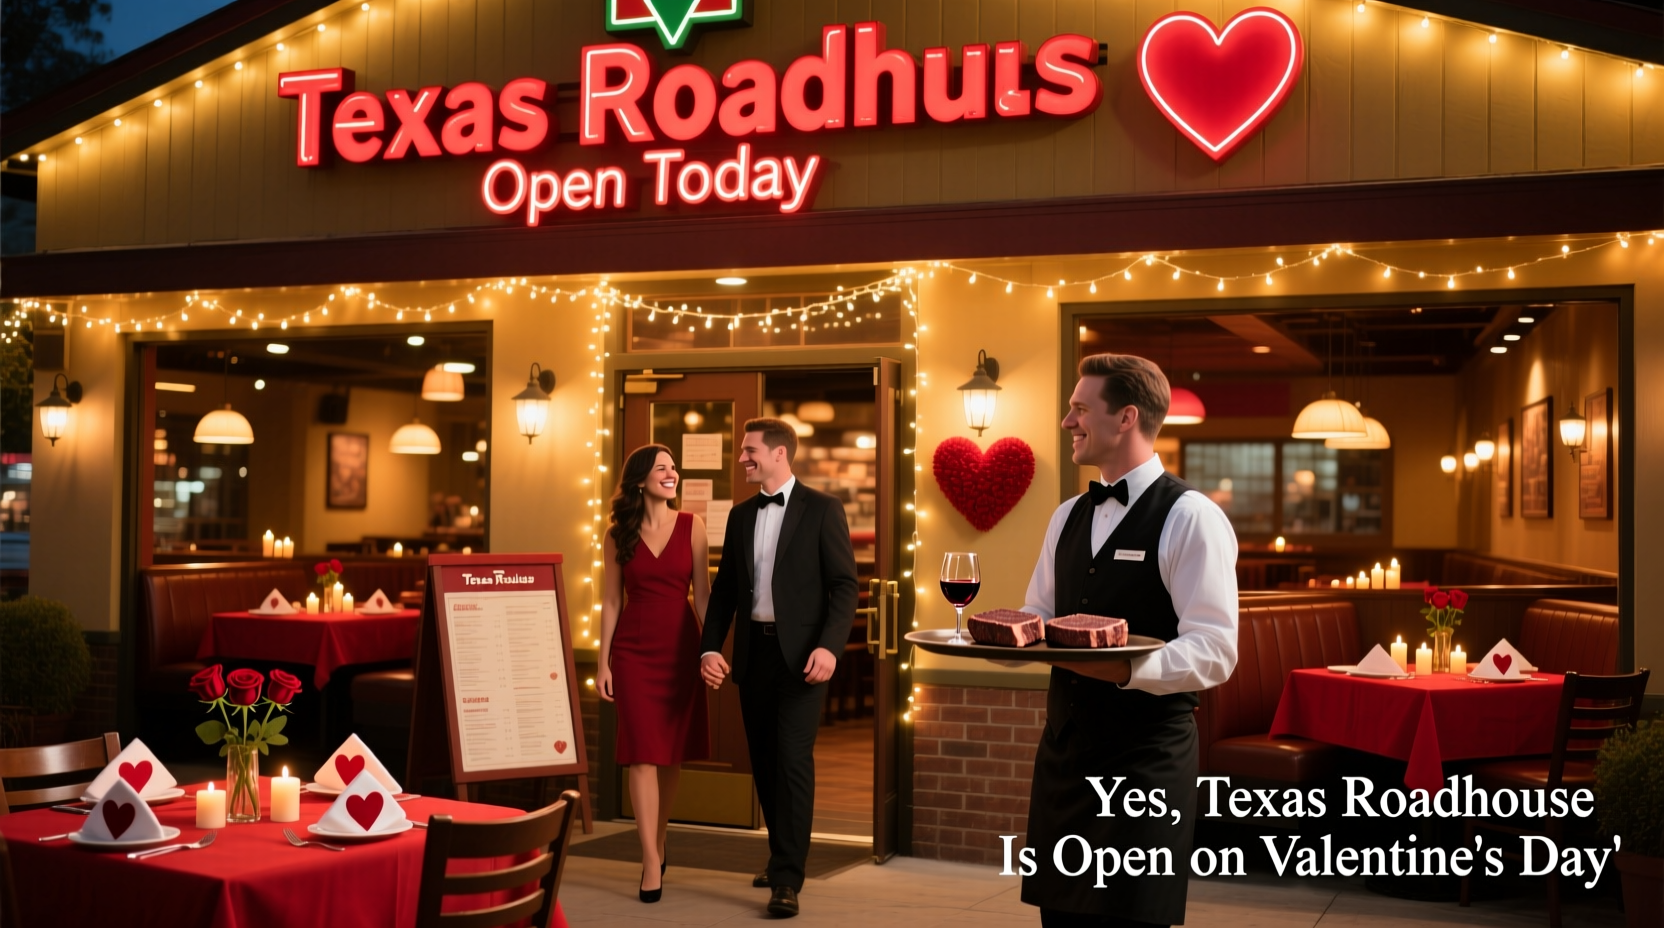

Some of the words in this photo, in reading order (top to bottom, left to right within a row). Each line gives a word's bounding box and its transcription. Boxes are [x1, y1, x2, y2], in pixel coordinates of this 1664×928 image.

[278, 67, 551, 166] Texas
[482, 158, 627, 227] Open
[642, 143, 821, 213] Today
